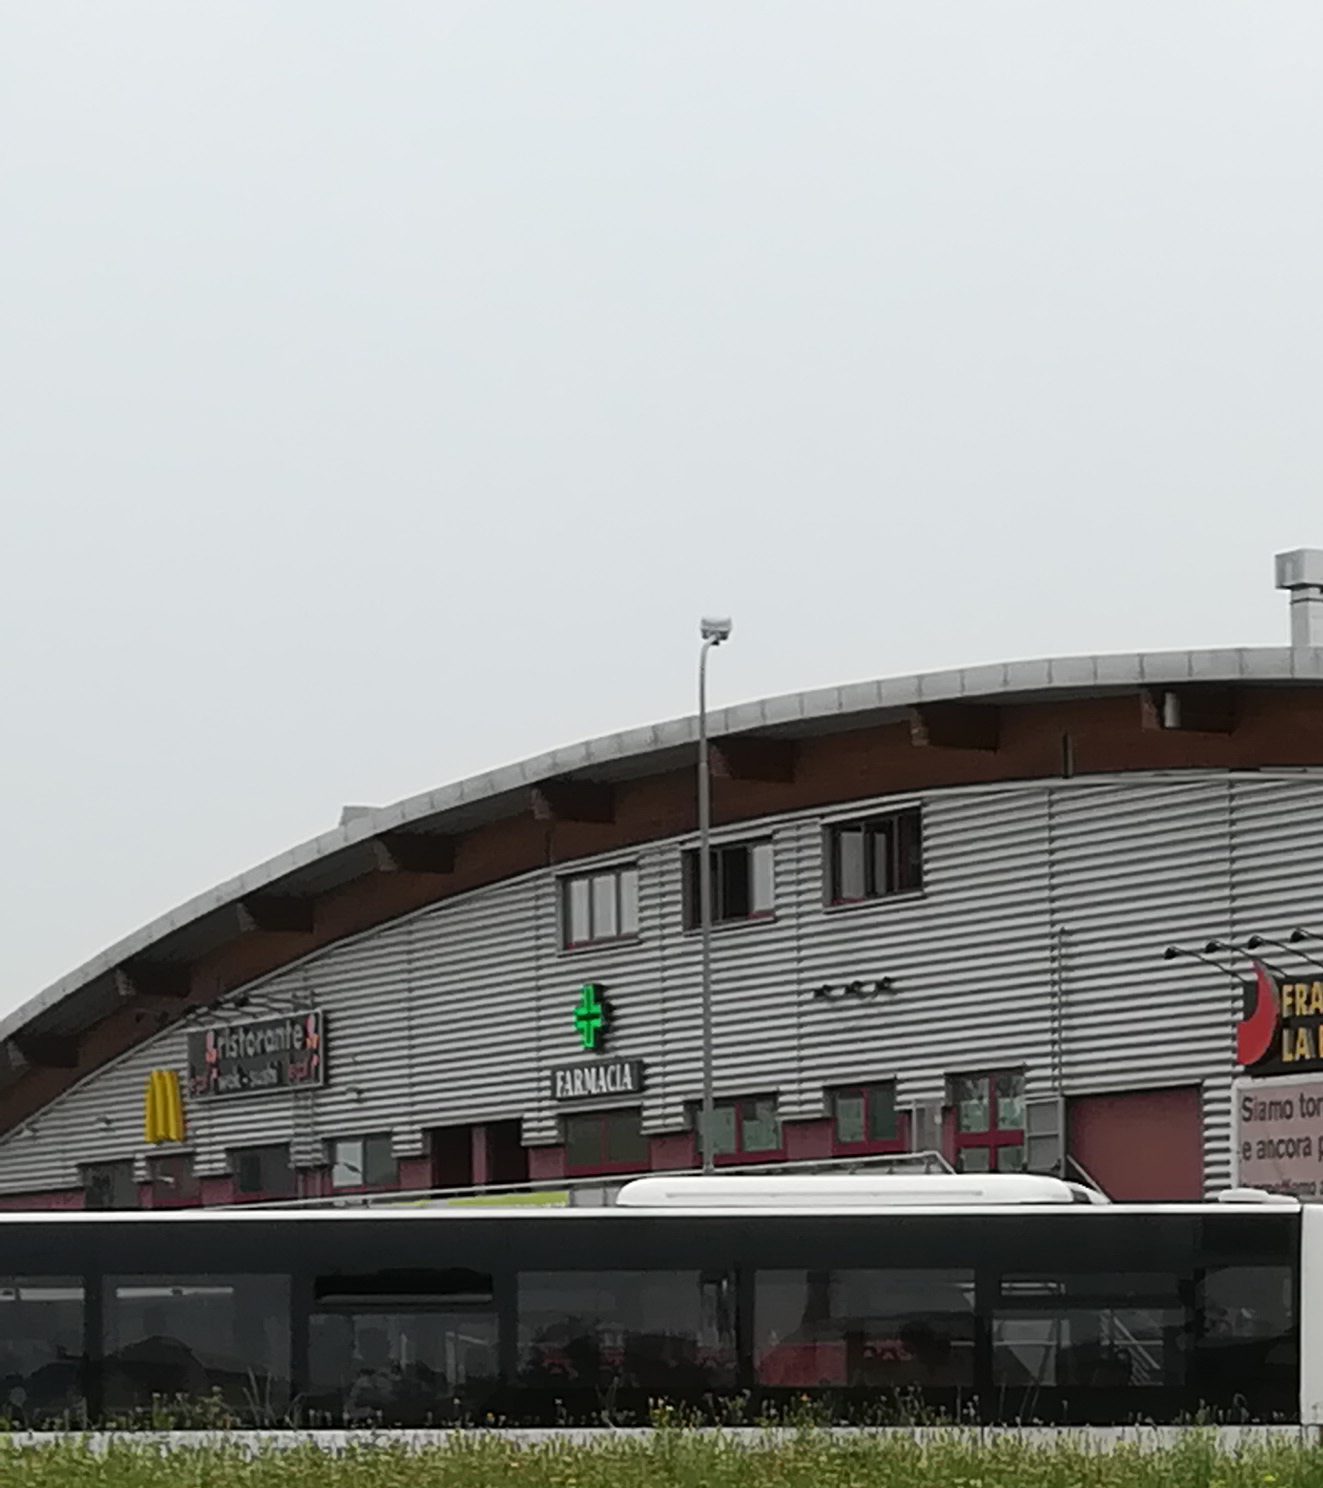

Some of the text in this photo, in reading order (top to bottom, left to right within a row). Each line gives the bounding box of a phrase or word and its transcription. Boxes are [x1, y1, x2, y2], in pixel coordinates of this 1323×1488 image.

[217, 1019, 304, 1058] ristorante
[1282, 1027, 1316, 1062] LA
[556, 1063, 633, 1097] FARMACIA
[1241, 1097, 1294, 1123] Siamo
[1242, 1142, 1253, 1161] e
[1256, 1132, 1313, 1161] ancora
